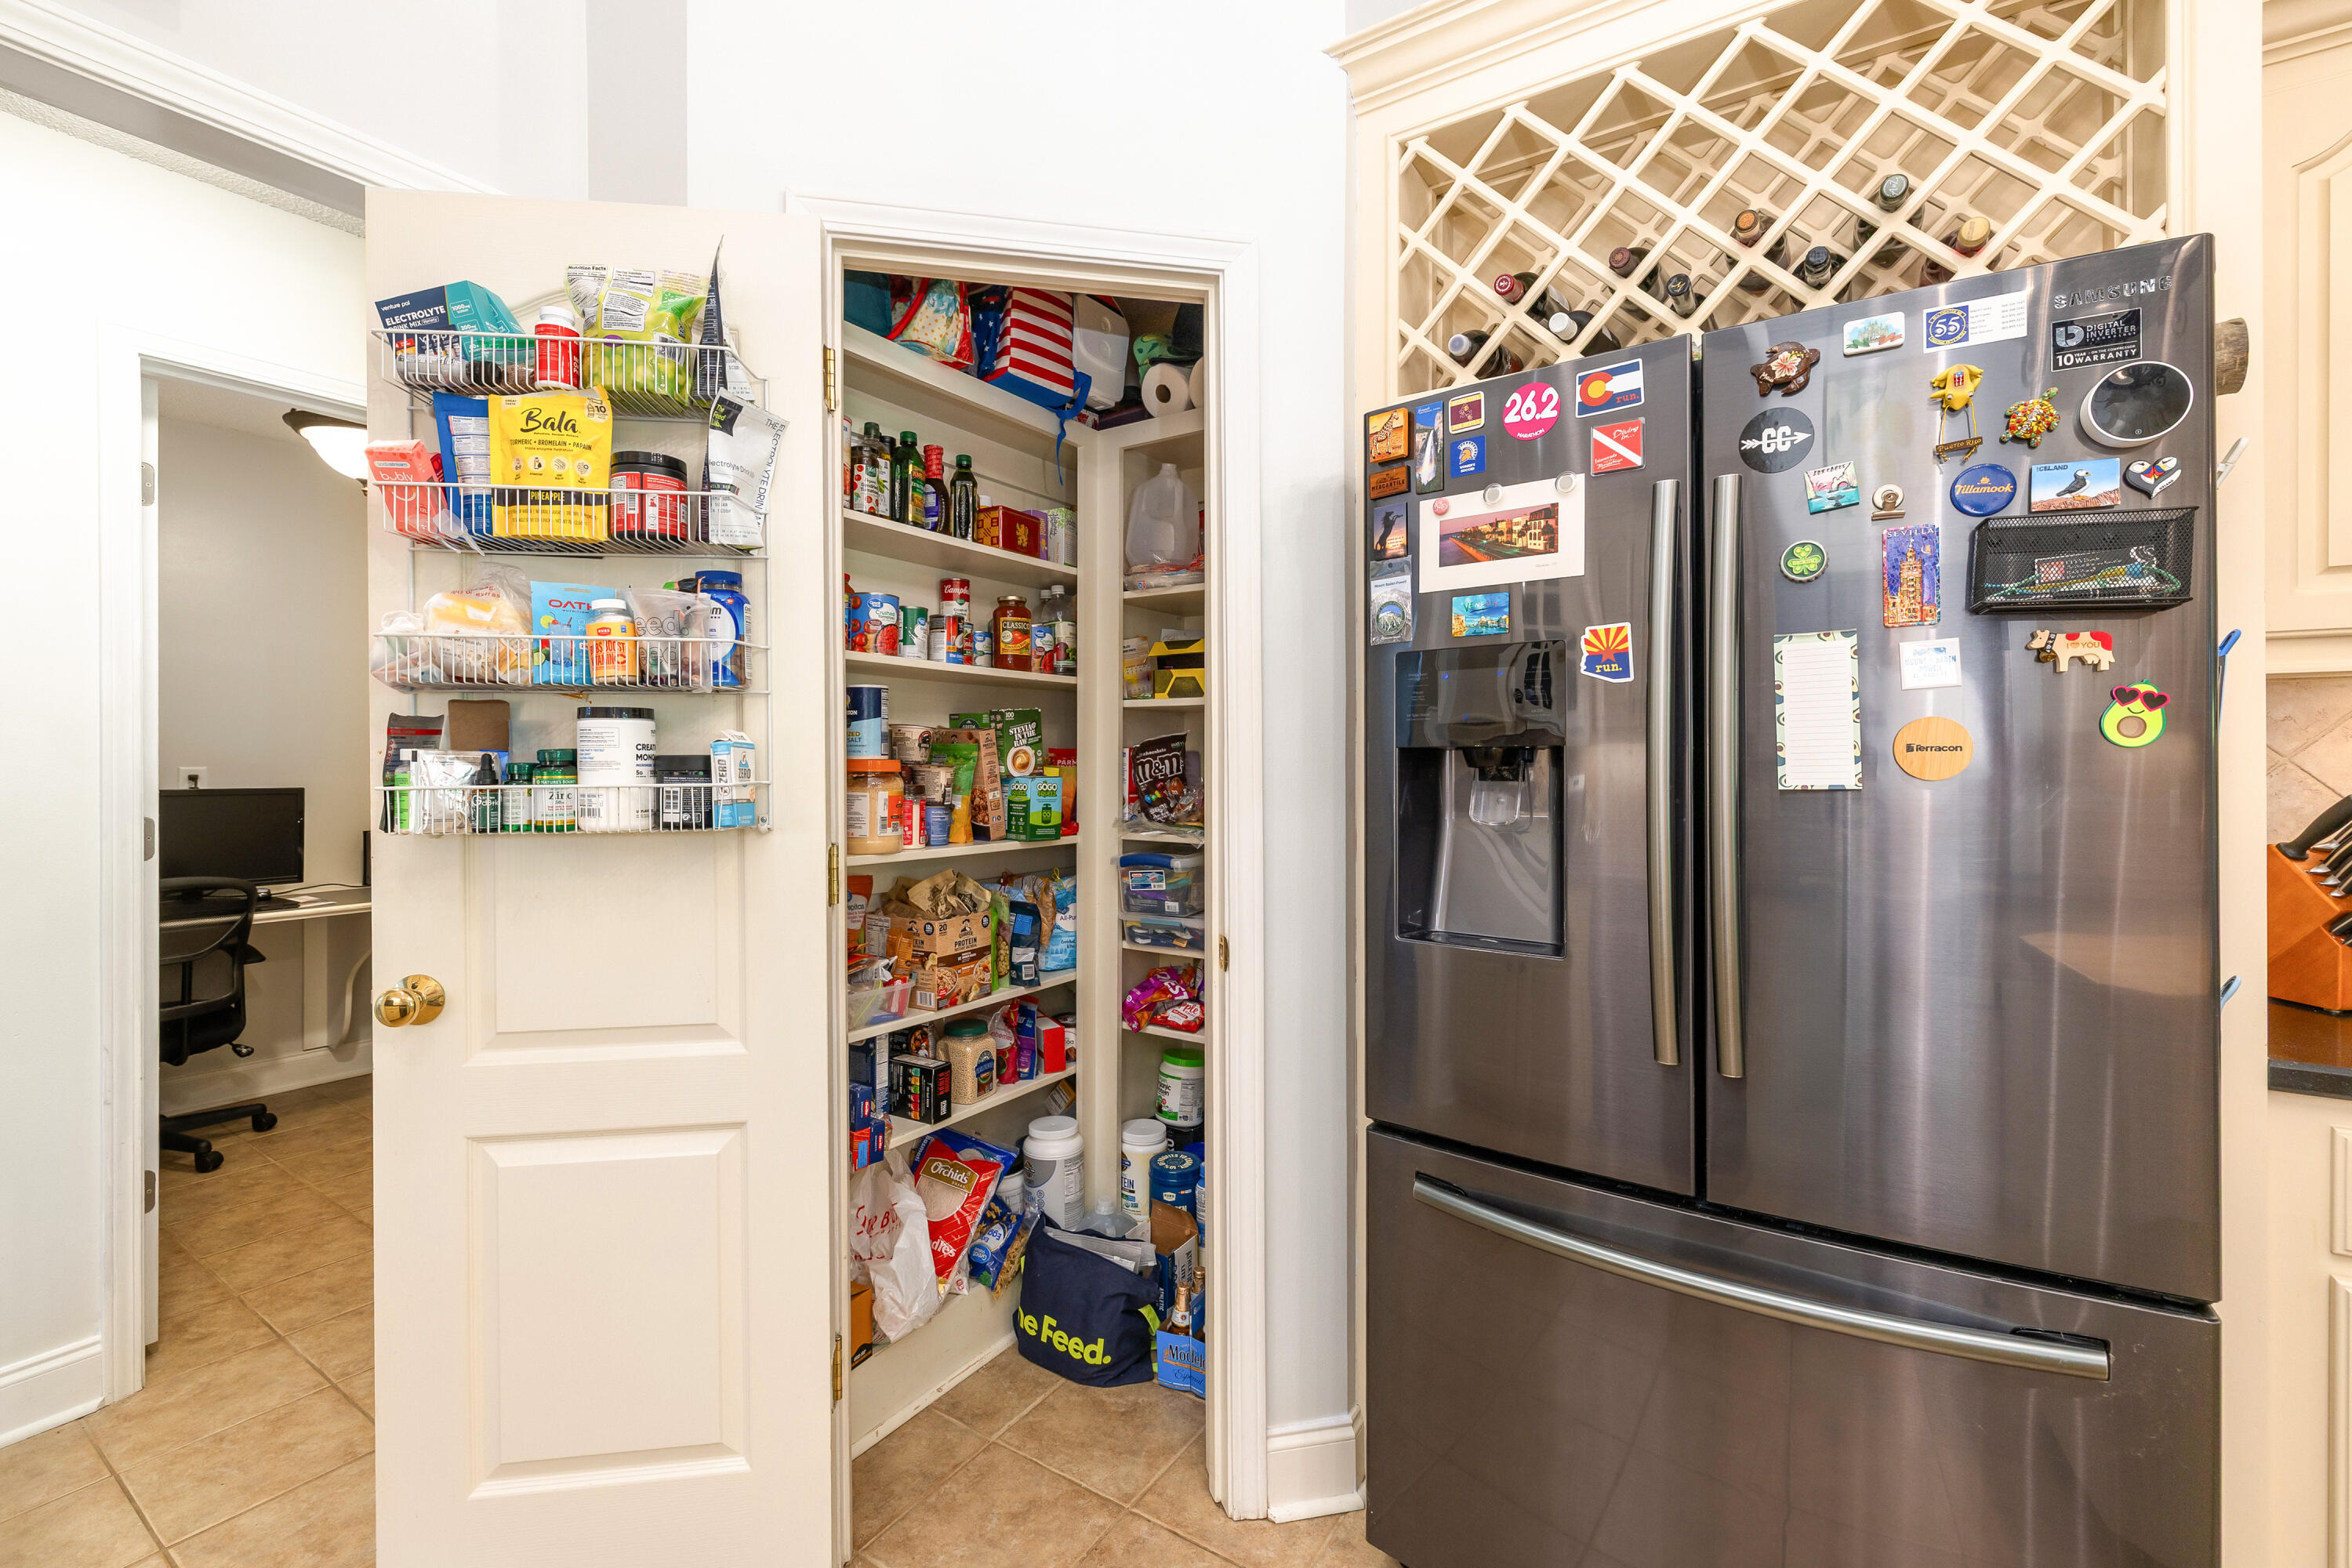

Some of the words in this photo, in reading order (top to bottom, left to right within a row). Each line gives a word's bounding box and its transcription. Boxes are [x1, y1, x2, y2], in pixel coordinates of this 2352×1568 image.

[2054, 275, 2174, 309] SAMSUNG
[380, 302, 401, 311] venture
[401, 299, 411, 308] pal
[385, 305, 446, 327] ELECTROLYTE
[409, 320, 422, 328] MIX
[1934, 316, 1960, 337] 55
[2086, 320, 2125, 332] DIGITAL
[2086, 325, 2136, 339] INVERTER
[2056, 354, 2074, 367] 10
[2074, 348, 2137, 364] WARRANTY
[1616, 393, 1639, 404] run.
[1504, 387, 1559, 424] 26.2
[520, 408, 579, 434] Bala
[713, 412, 726, 421] Feed
[765, 418, 779, 430] THE
[1516, 428, 1544, 438] MARATHON
[572, 442, 592, 451] PAPAIN
[1371, 479, 1406, 492] MERCANTILE
[1955, 483, 2014, 495] Tillamook
[531, 491, 565, 502] PINEAPPLE
[755, 487, 768, 510] DRIN
[1886, 527, 1936, 538] SEVILLA
[1463, 600, 1498, 612] VENEZIA
[635, 609, 690, 637] eed.
[1002, 621, 1030, 630] CLASSICO
[1595, 662, 1623, 673] run.
[1009, 723, 1033, 735] STEVIA
[1014, 732, 1023, 741] IN
[1023, 730, 1036, 739] THE
[1013, 738, 1028, 748] RAW
[1915, 743, 1963, 753] Terracon
[717, 758, 728, 784] ZERO
[738, 768, 751, 779] ZERO
[954, 937, 978, 948] PROTEIN
[1180, 1003, 1199, 1014] ple
[991, 1031, 1013, 1041] nberries
[931, 1160, 969, 1185] Orchids
[986, 1228, 1003, 1240] Egg
[973, 1250, 986, 1261] Great
[1040, 1315, 1112, 1366] Feed.
